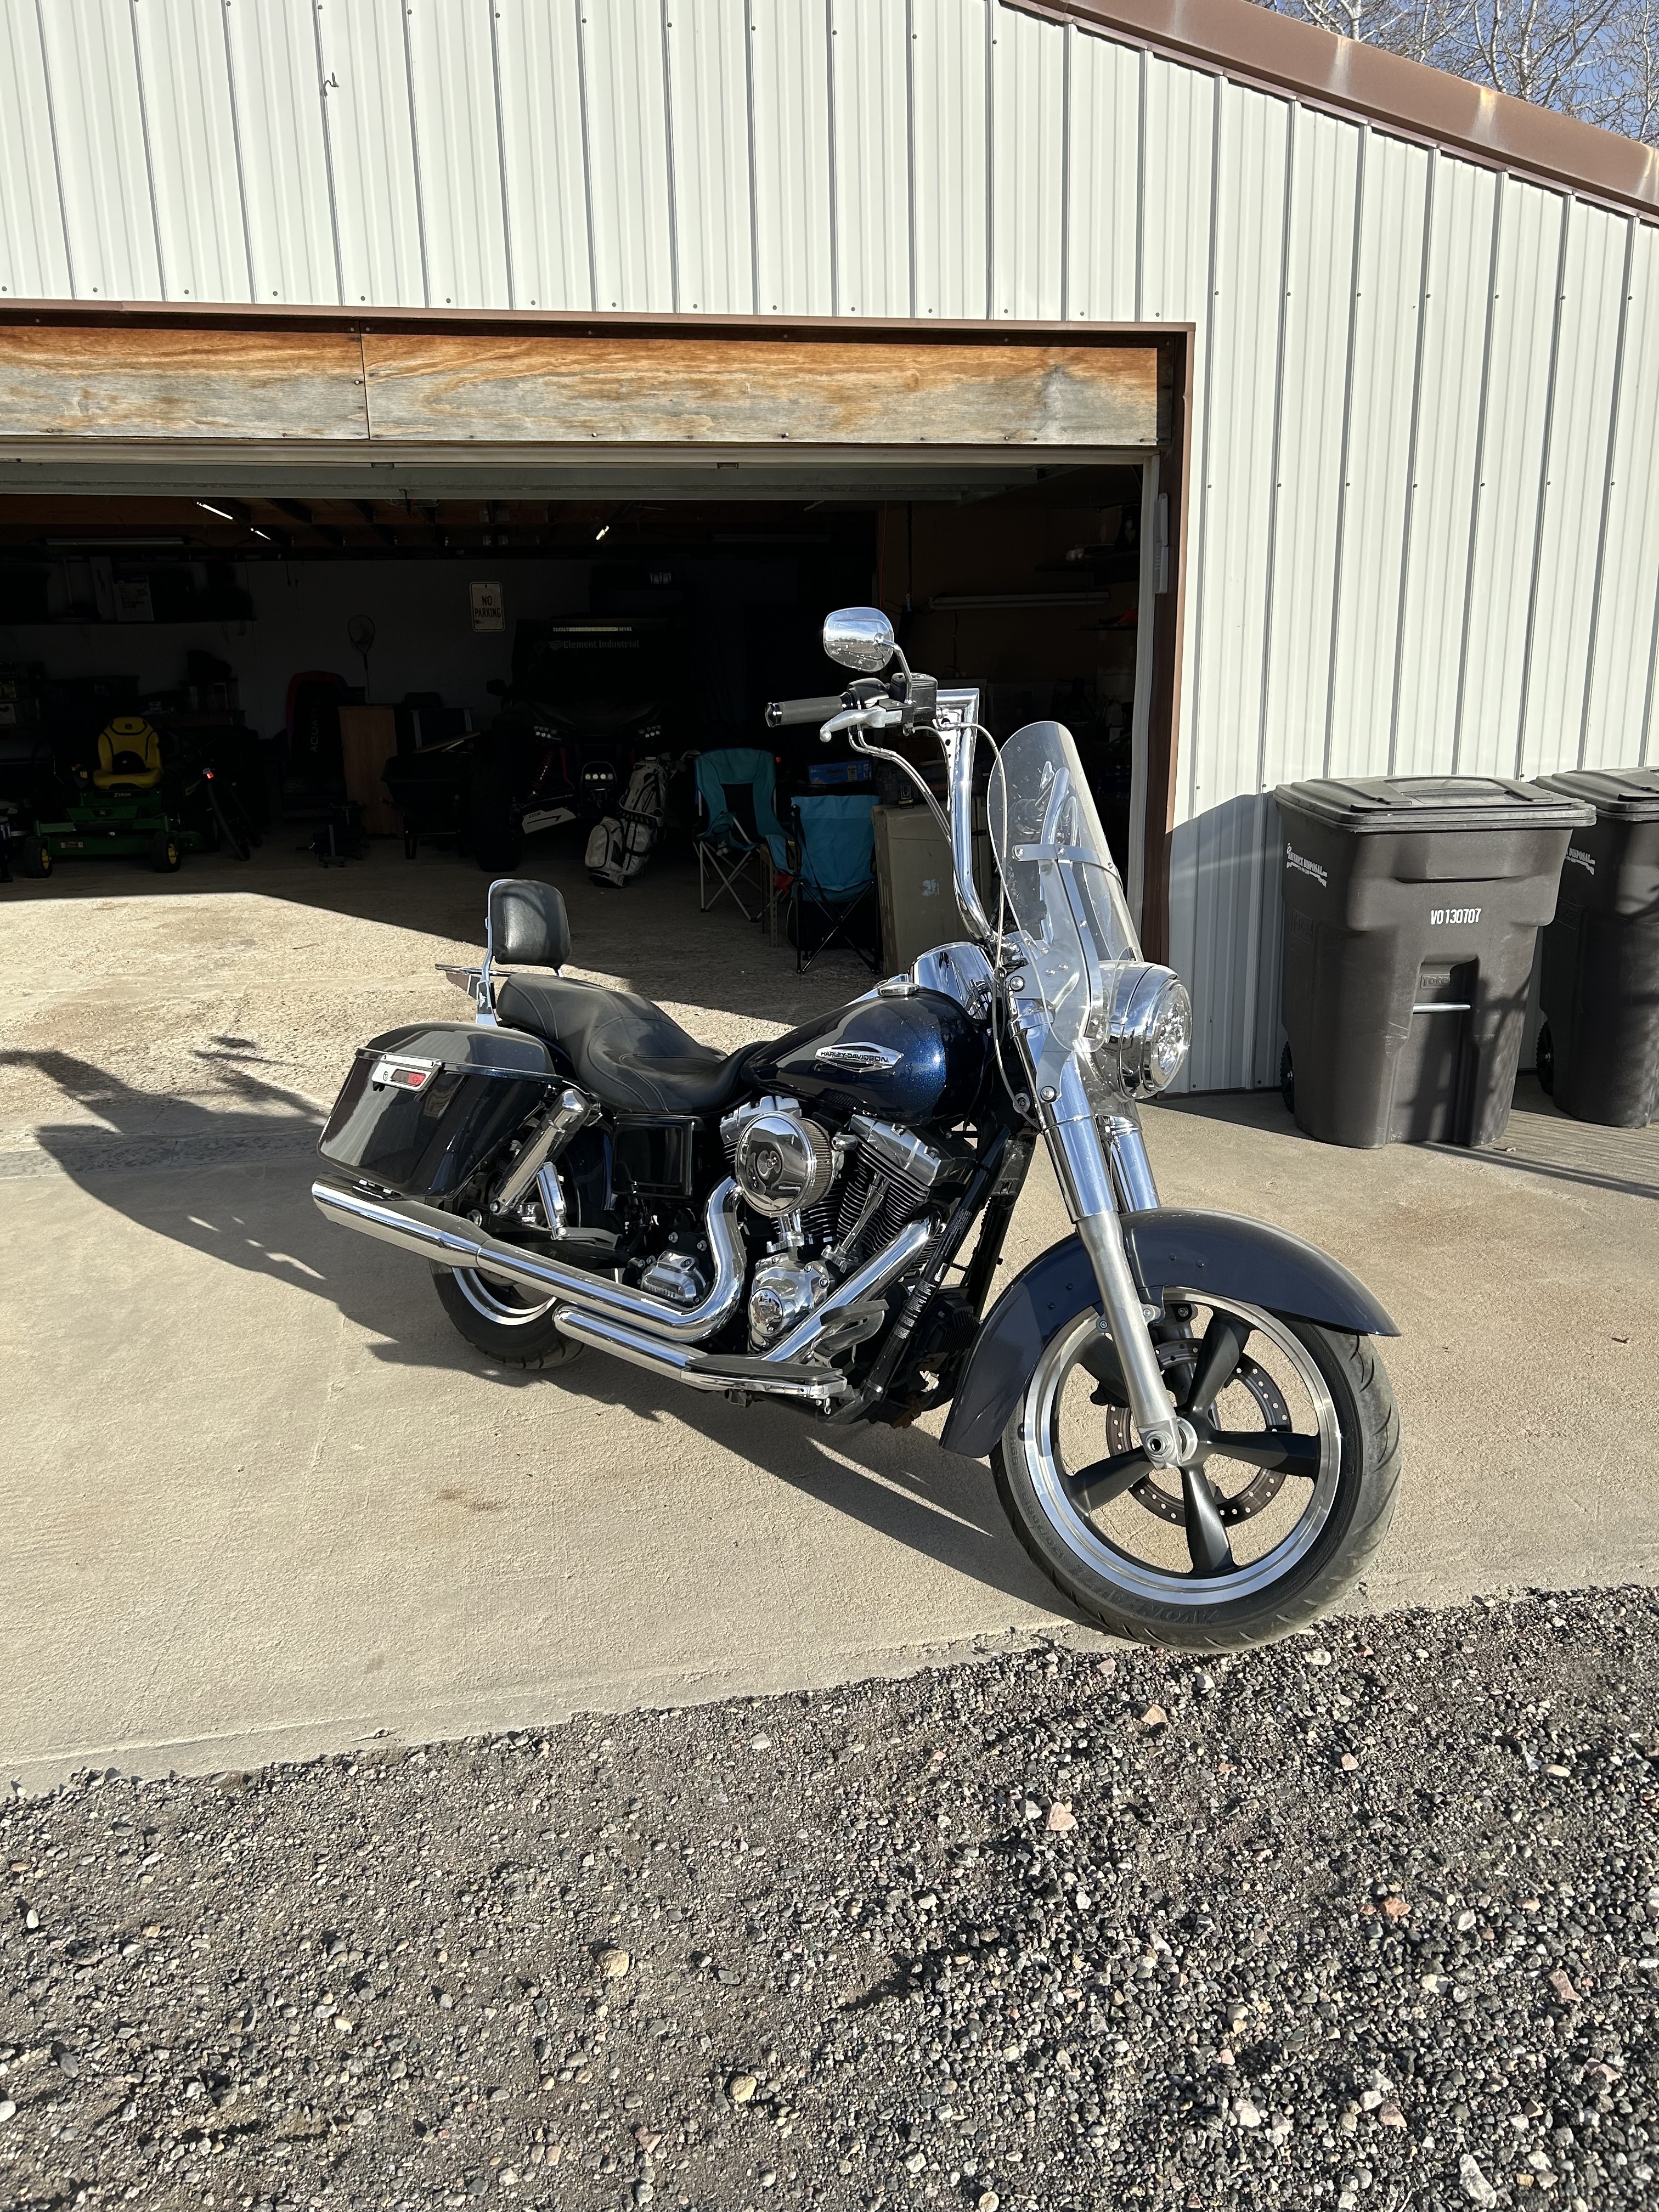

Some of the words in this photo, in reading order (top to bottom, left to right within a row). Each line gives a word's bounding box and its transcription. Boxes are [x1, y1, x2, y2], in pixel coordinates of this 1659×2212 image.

[482, 596, 492, 606] NO
[475, 608, 501, 618] PARKING
[563, 640, 597, 649] Element
[599, 639, 640, 649] Industrial
[821, 1051, 889, 1063] HARLEY-DAVIDSON
